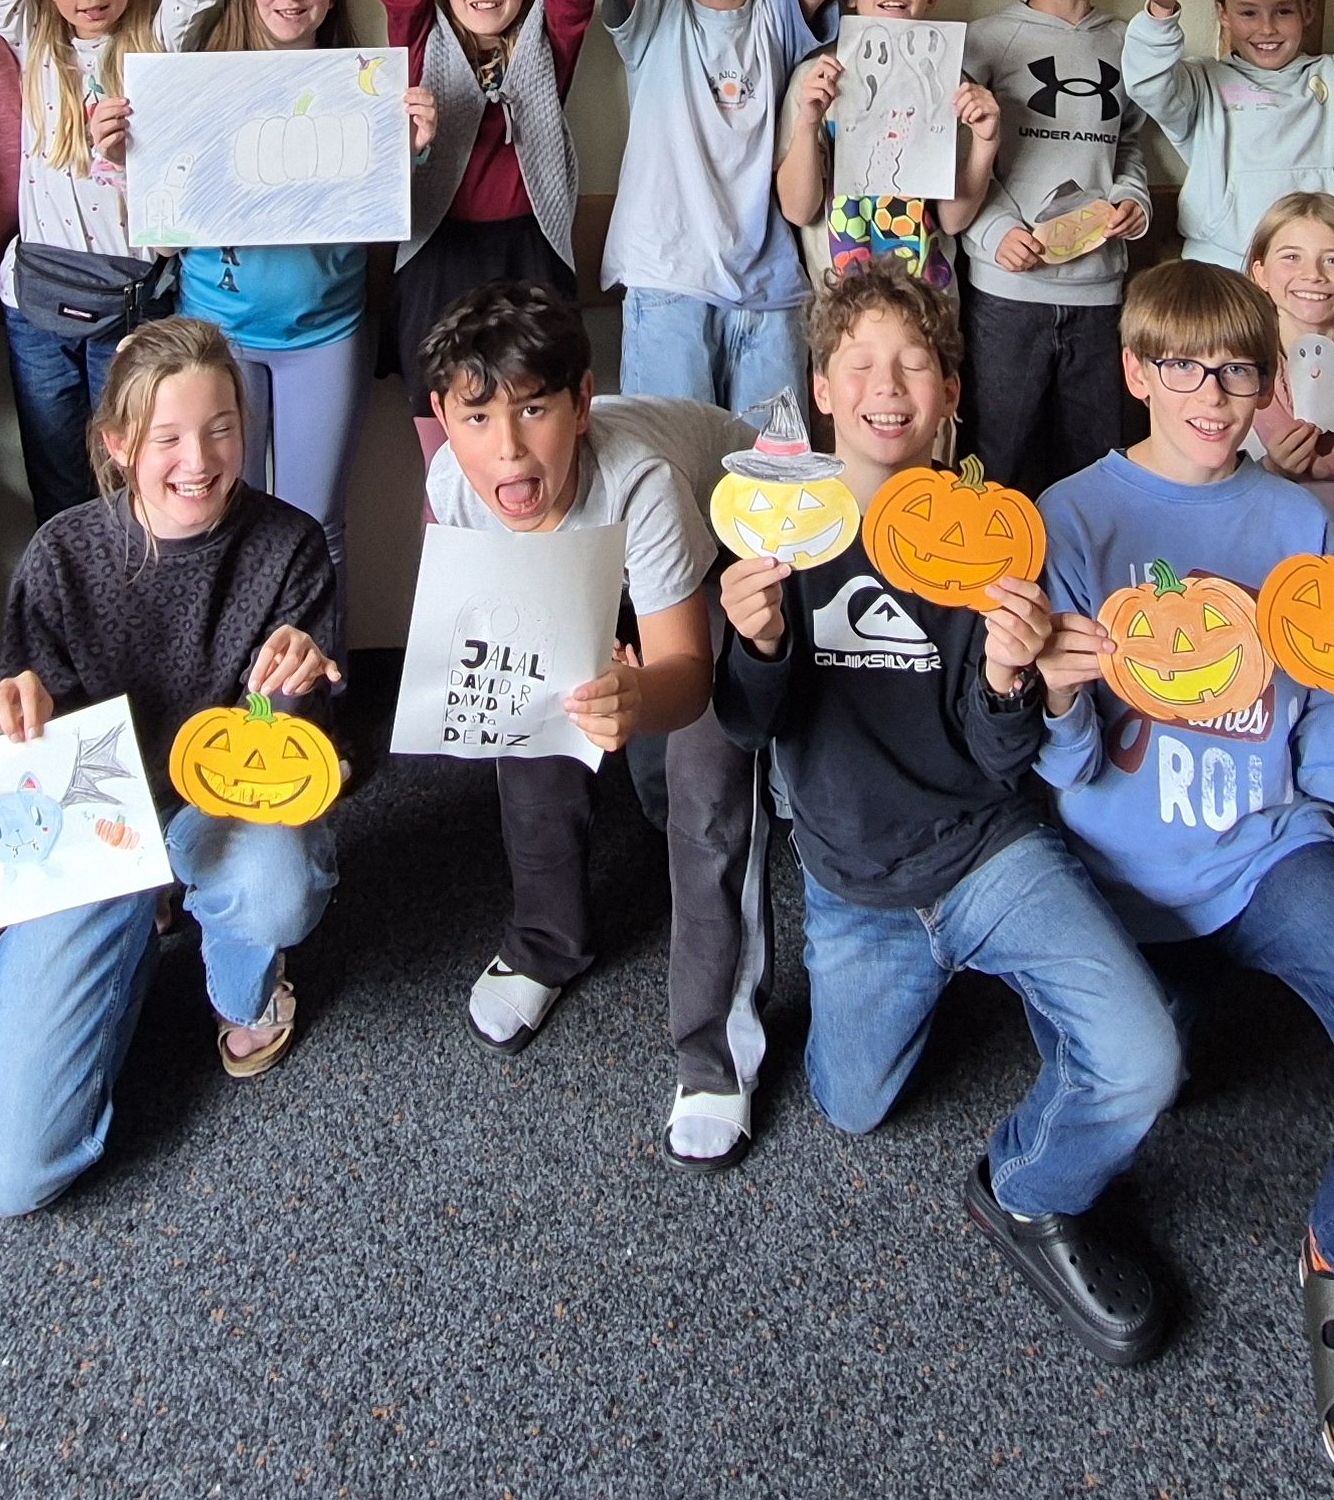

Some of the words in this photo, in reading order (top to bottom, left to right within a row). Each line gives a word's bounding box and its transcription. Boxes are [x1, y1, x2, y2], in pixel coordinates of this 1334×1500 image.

[1018, 126, 1070, 141] UNDER
[460, 639, 545, 681] JALAL
[814, 652, 942, 673] QUIKSILVER
[447, 690, 498, 711] DAVID
[443, 726, 531, 747] DENIZ
